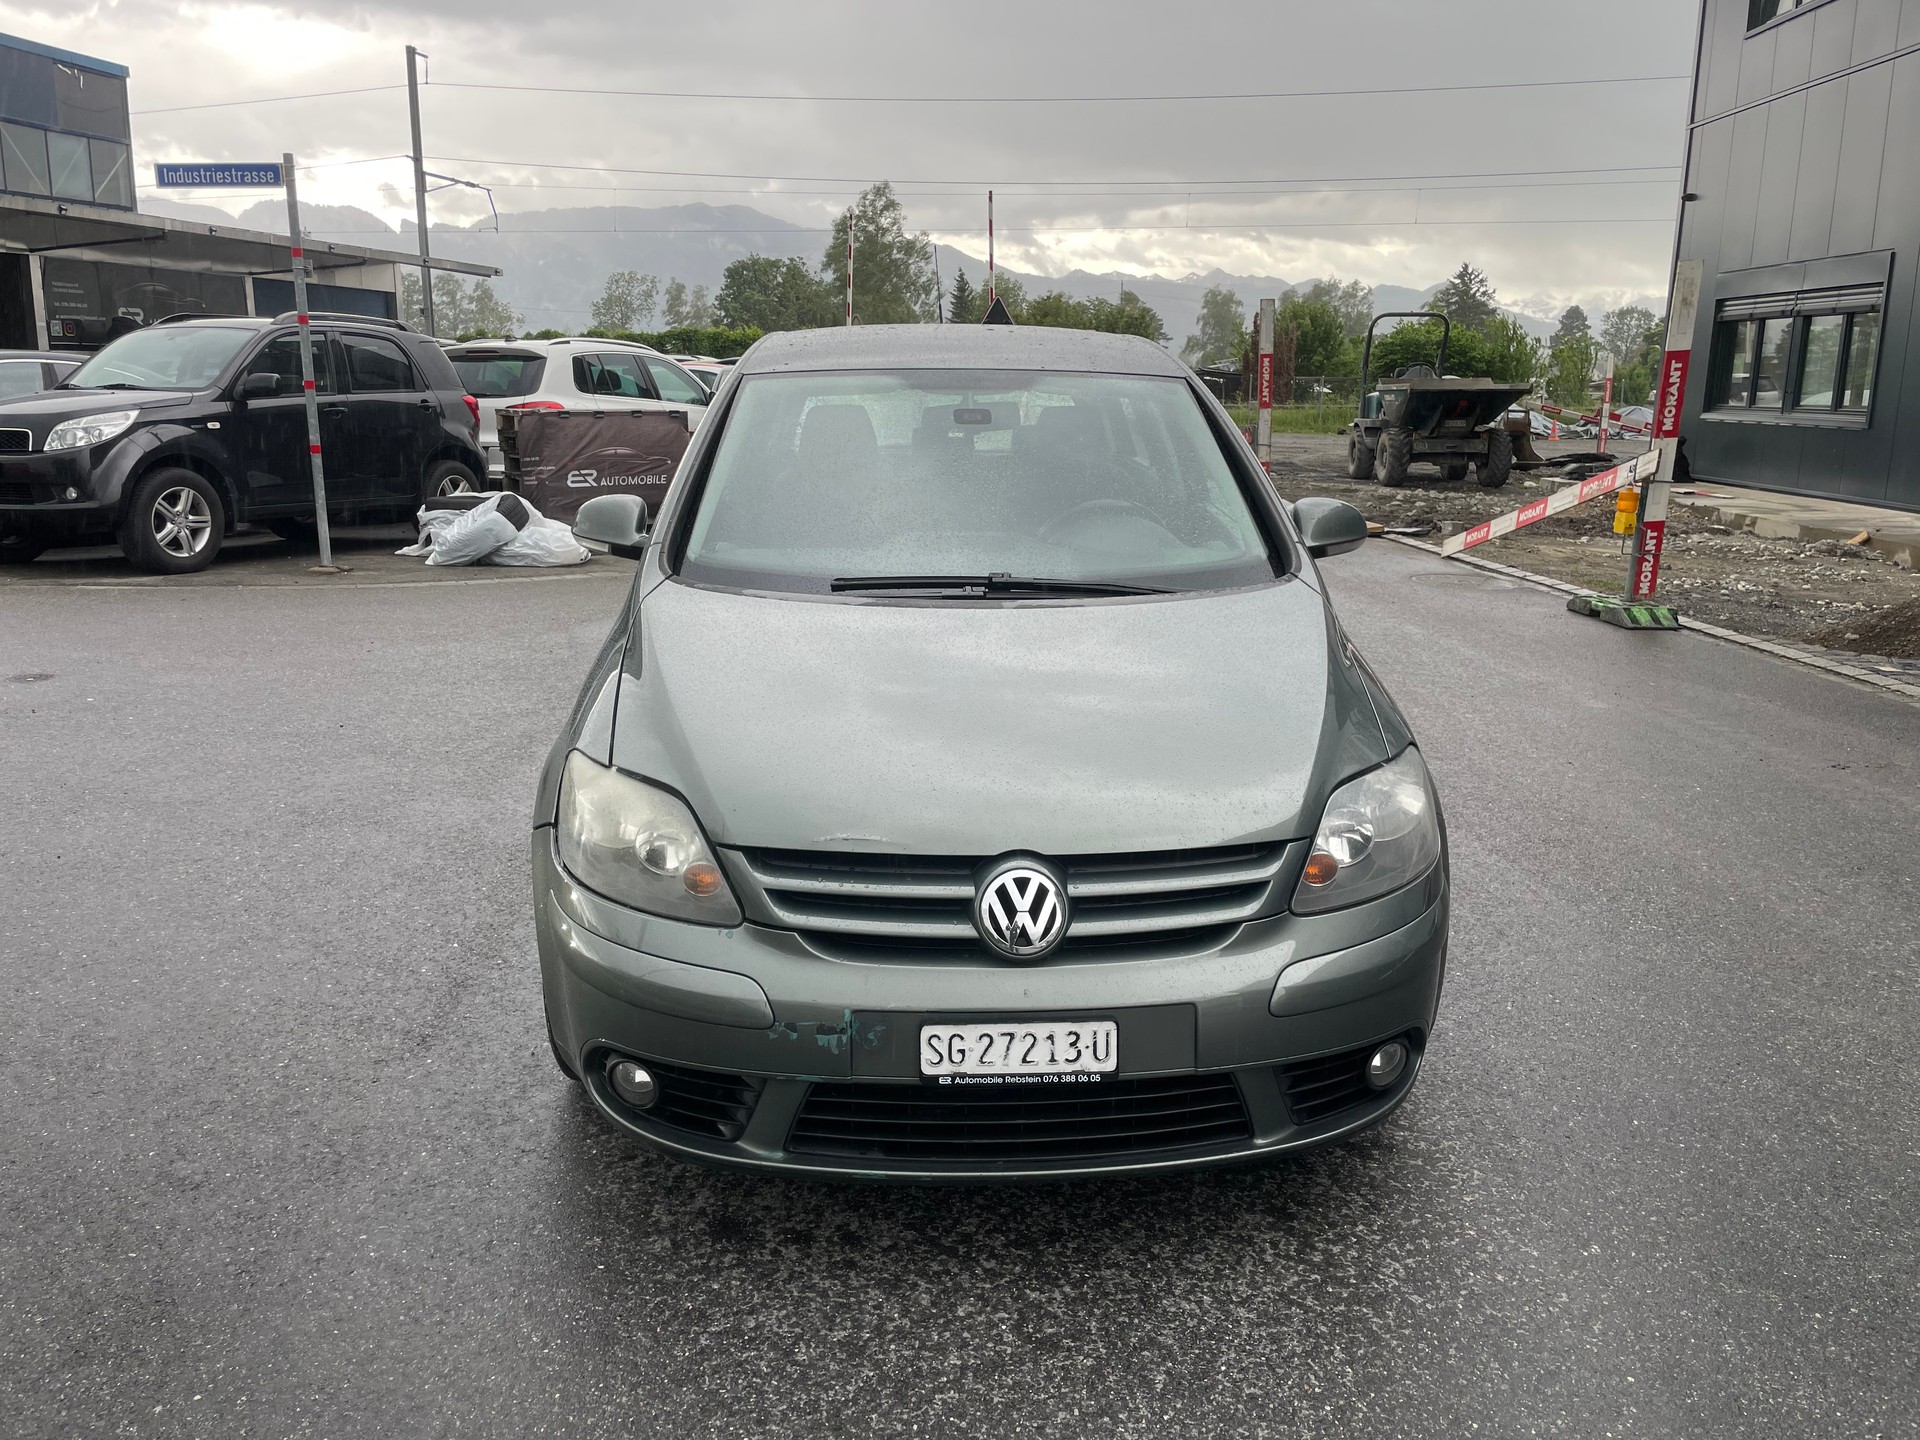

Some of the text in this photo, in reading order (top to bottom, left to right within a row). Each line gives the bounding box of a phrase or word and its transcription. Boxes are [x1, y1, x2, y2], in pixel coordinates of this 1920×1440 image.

[163, 167, 275, 183] Industriestrasse
[1262, 357, 1271, 403] MORANT
[1662, 359, 1683, 431] MORANT
[601, 474, 668, 486] AUTOMOBILE
[1519, 503, 1545, 523] MORANT
[1466, 527, 1489, 543] MORANT
[1639, 529, 1658, 594] MORANT
[954, 1076, 1003, 1085] Automobile
[1005, 1075, 1041, 1084] Rebstein
[1043, 1075, 1059, 1083] 076
[1060, 1074, 1076, 1083] 388
[1078, 1074, 1089, 1082] 06
[1090, 1074, 1101, 1082] 05
